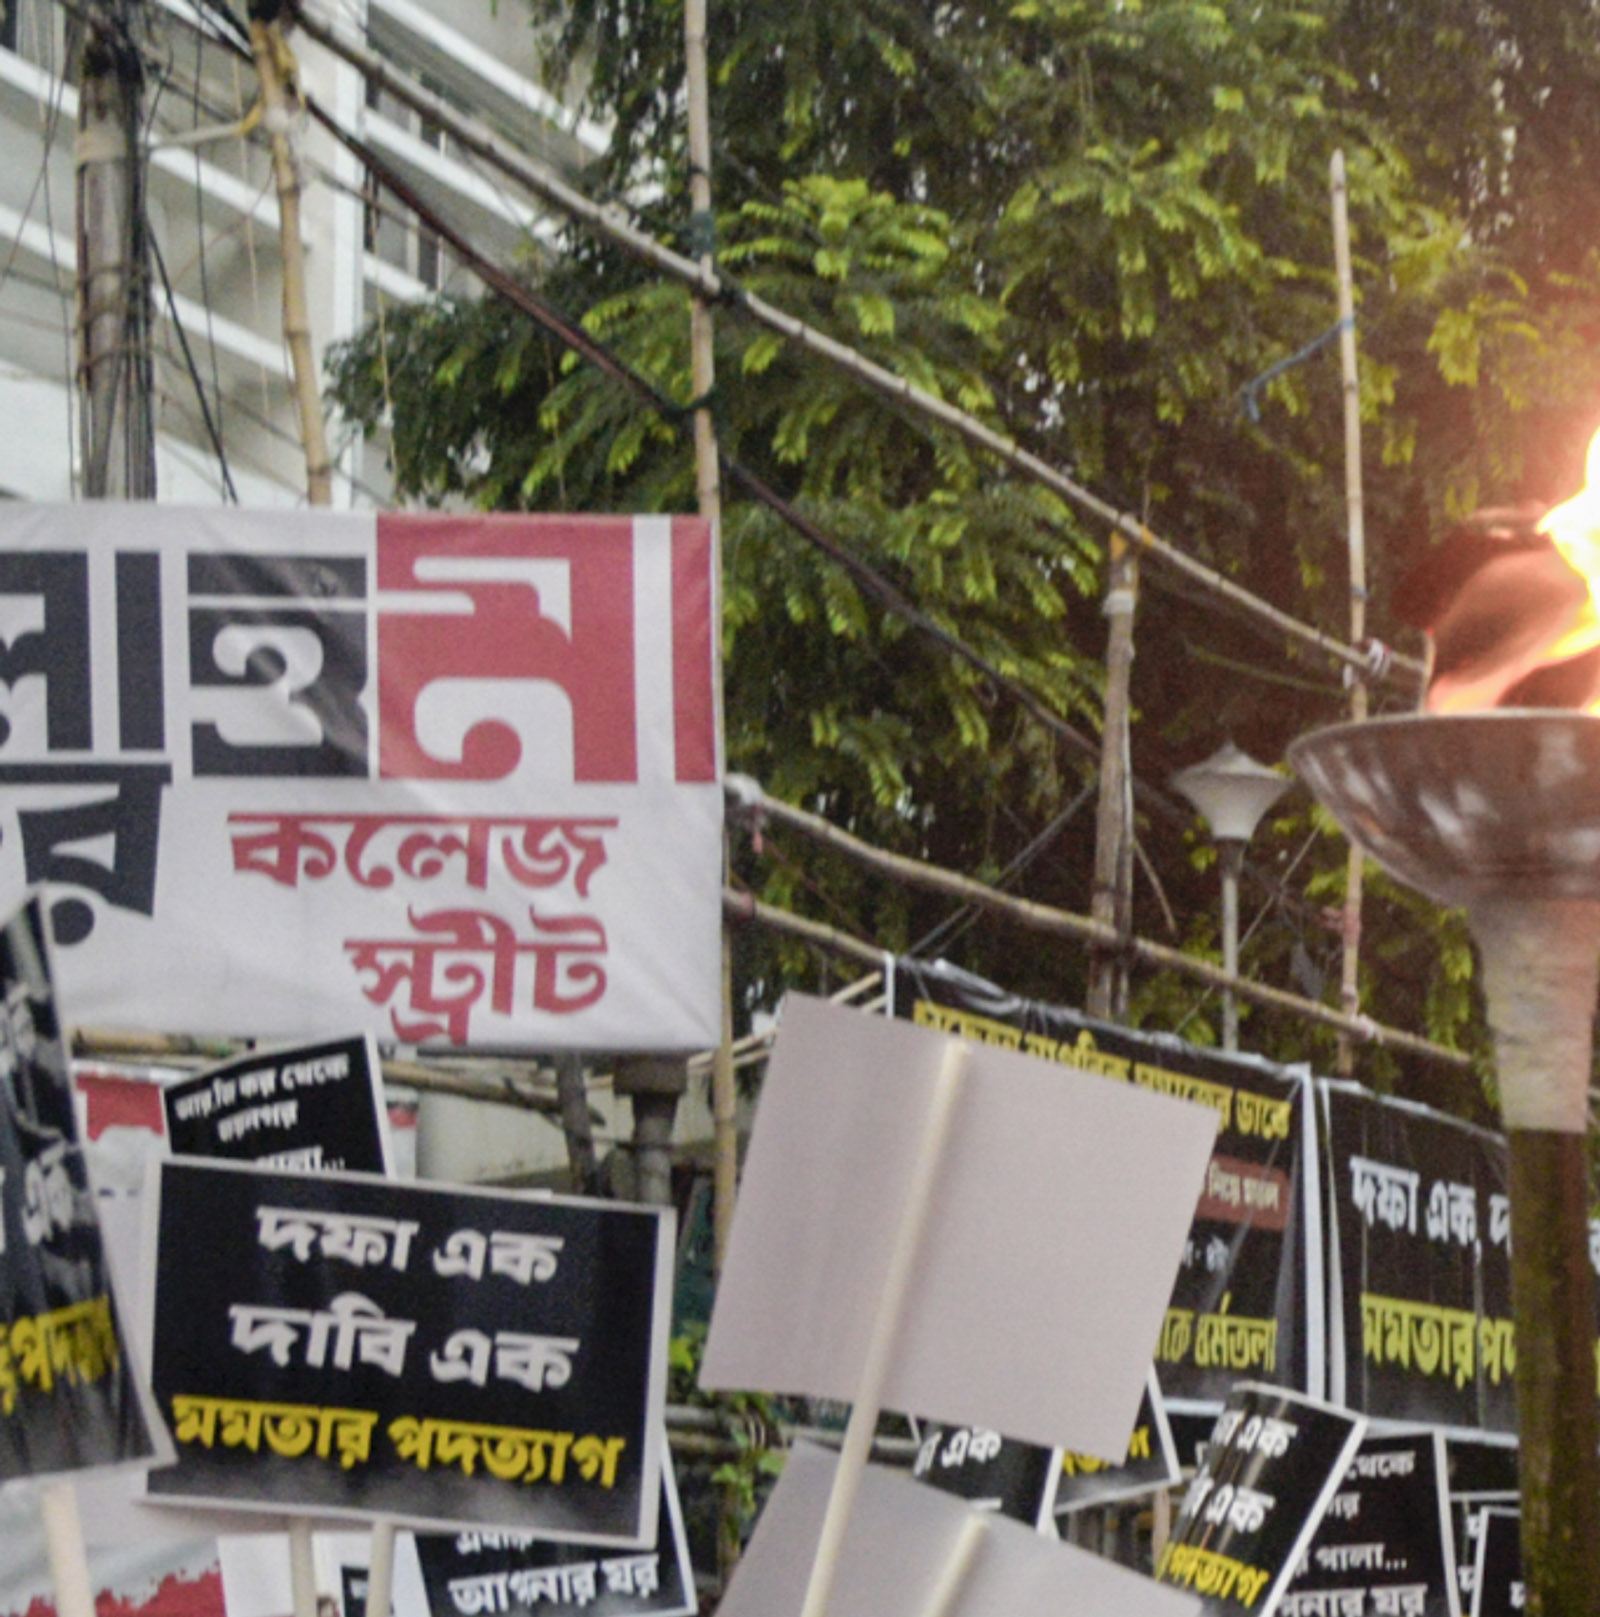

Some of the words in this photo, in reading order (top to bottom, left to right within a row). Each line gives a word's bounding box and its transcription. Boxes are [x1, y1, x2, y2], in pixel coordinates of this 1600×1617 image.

[228, 813, 618, 898] কলেজ
[344, 904, 607, 1046] স্ট্রীট
[1350, 1155, 1418, 1236] দফা
[256, 1205, 420, 1272] দফা
[433, 1228, 564, 1285] এক
[228, 1291, 416, 1377] দাবি
[430, 1329, 580, 1393] এক
[1360, 1291, 1477, 1390] মমতার
[172, 1394, 379, 1469] মমতার
[388, 1415, 625, 1488] পদত্যাগ
[448, 1562, 597, 1615] আপনার
[602, 1553, 660, 1598] ঘর
